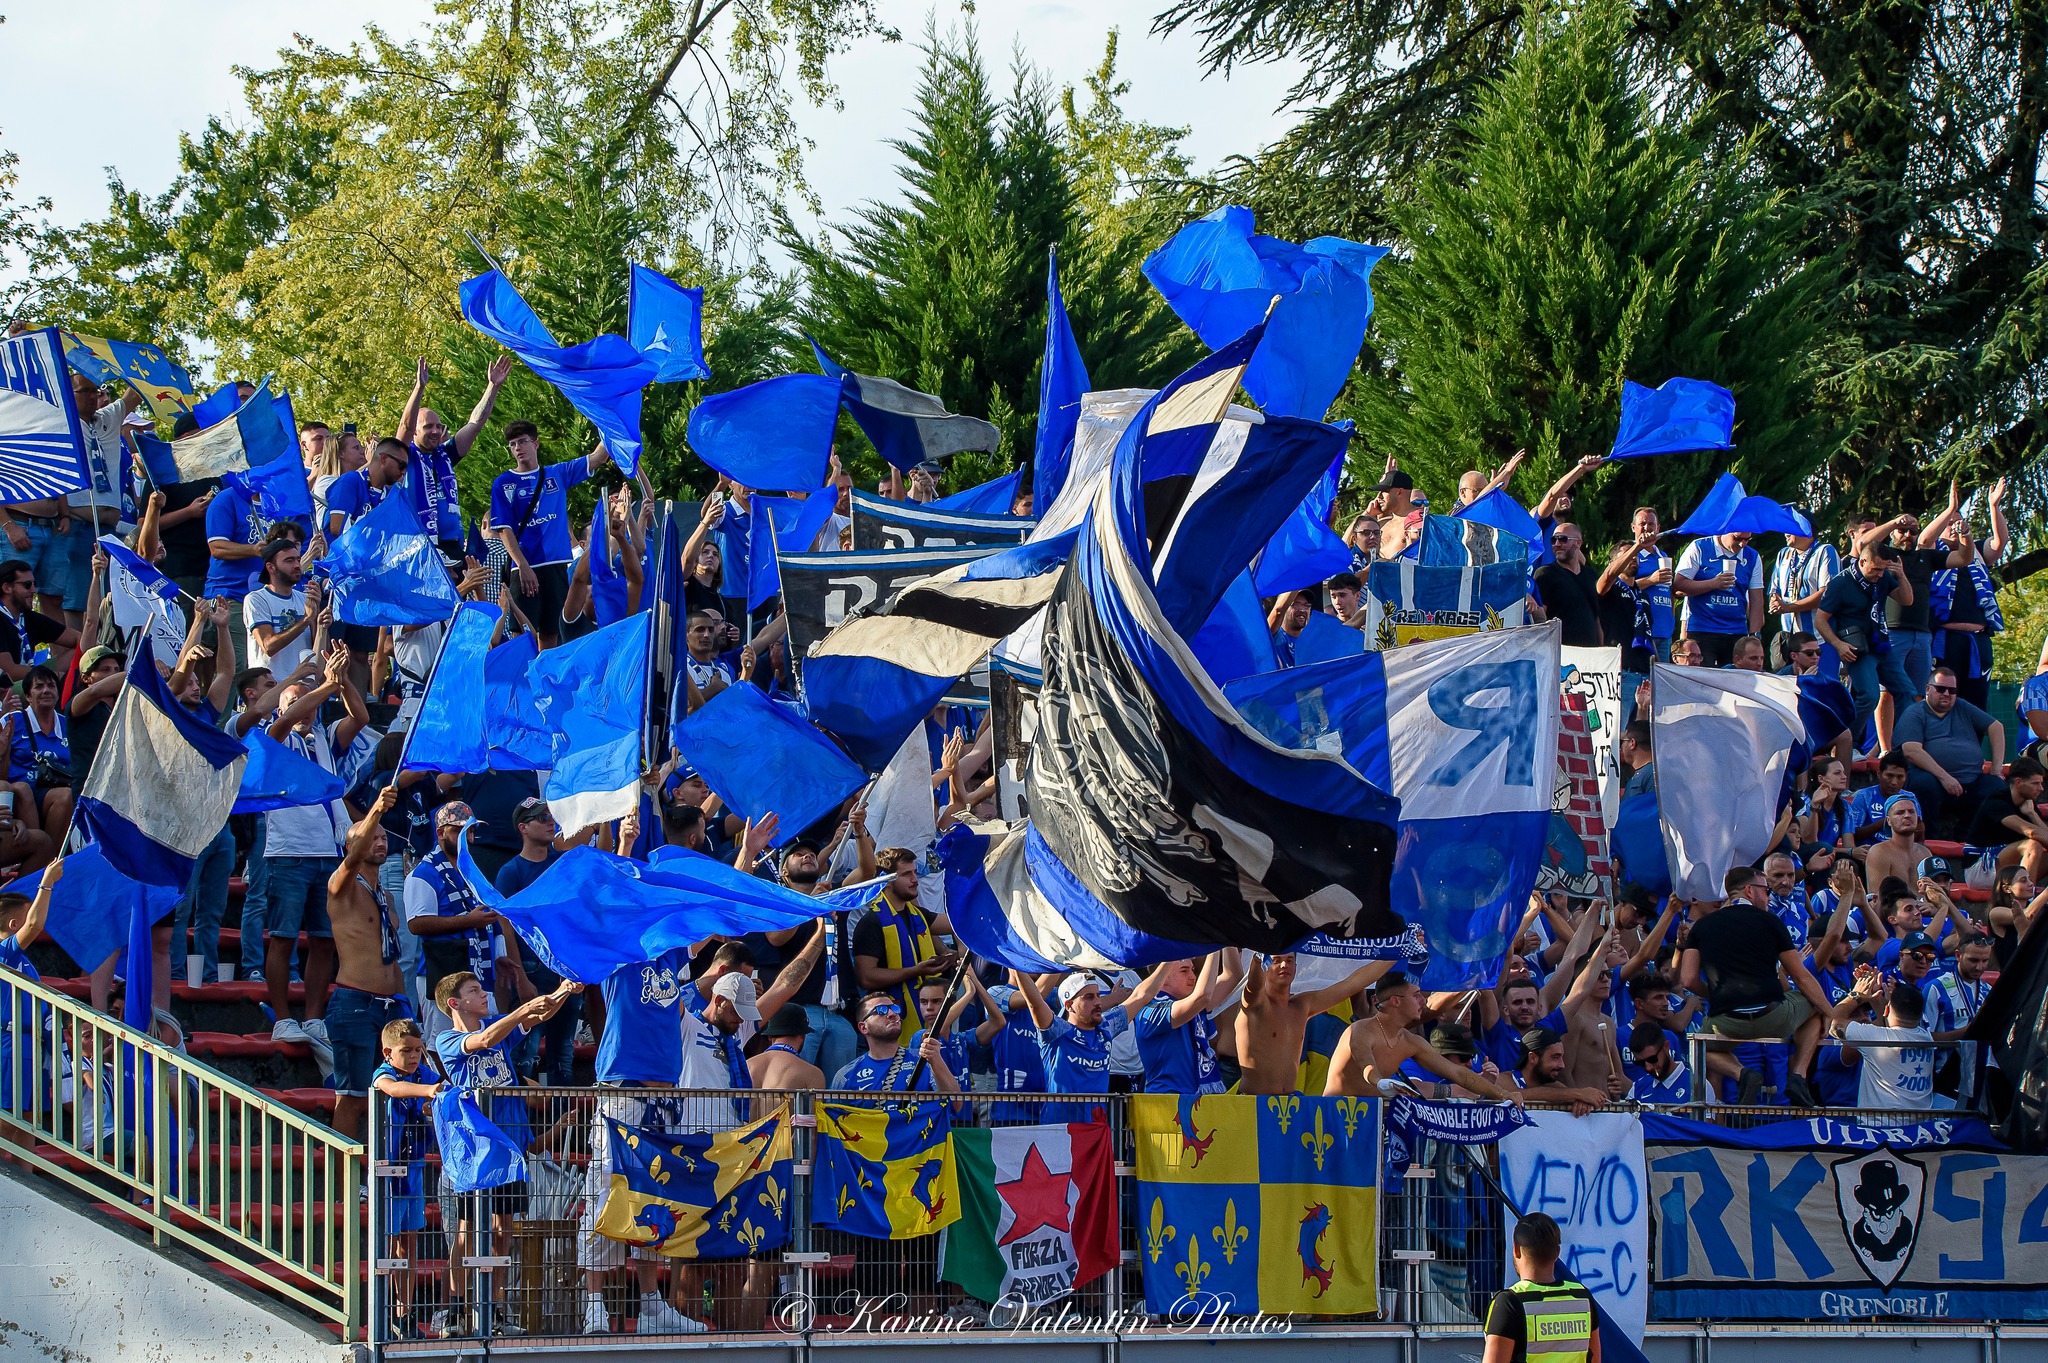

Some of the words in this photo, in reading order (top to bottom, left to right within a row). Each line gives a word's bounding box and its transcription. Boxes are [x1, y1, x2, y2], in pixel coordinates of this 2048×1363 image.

[1415, 1103, 1469, 1128] GRENOBLE
[1470, 1106, 1493, 1128] FOOT
[1427, 1128, 1458, 1141] gagnons
[1458, 1133, 1469, 1141] les
[1469, 1130, 1498, 1141] sommets
[1806, 1117, 1954, 1146] ULTRAS
[1651, 1146, 1836, 1281] RK
[1010, 1236, 1068, 1271] FORZA
[1820, 1290, 1949, 1317] GRENOBLE
[1539, 1319, 1588, 1336] SECURITE
